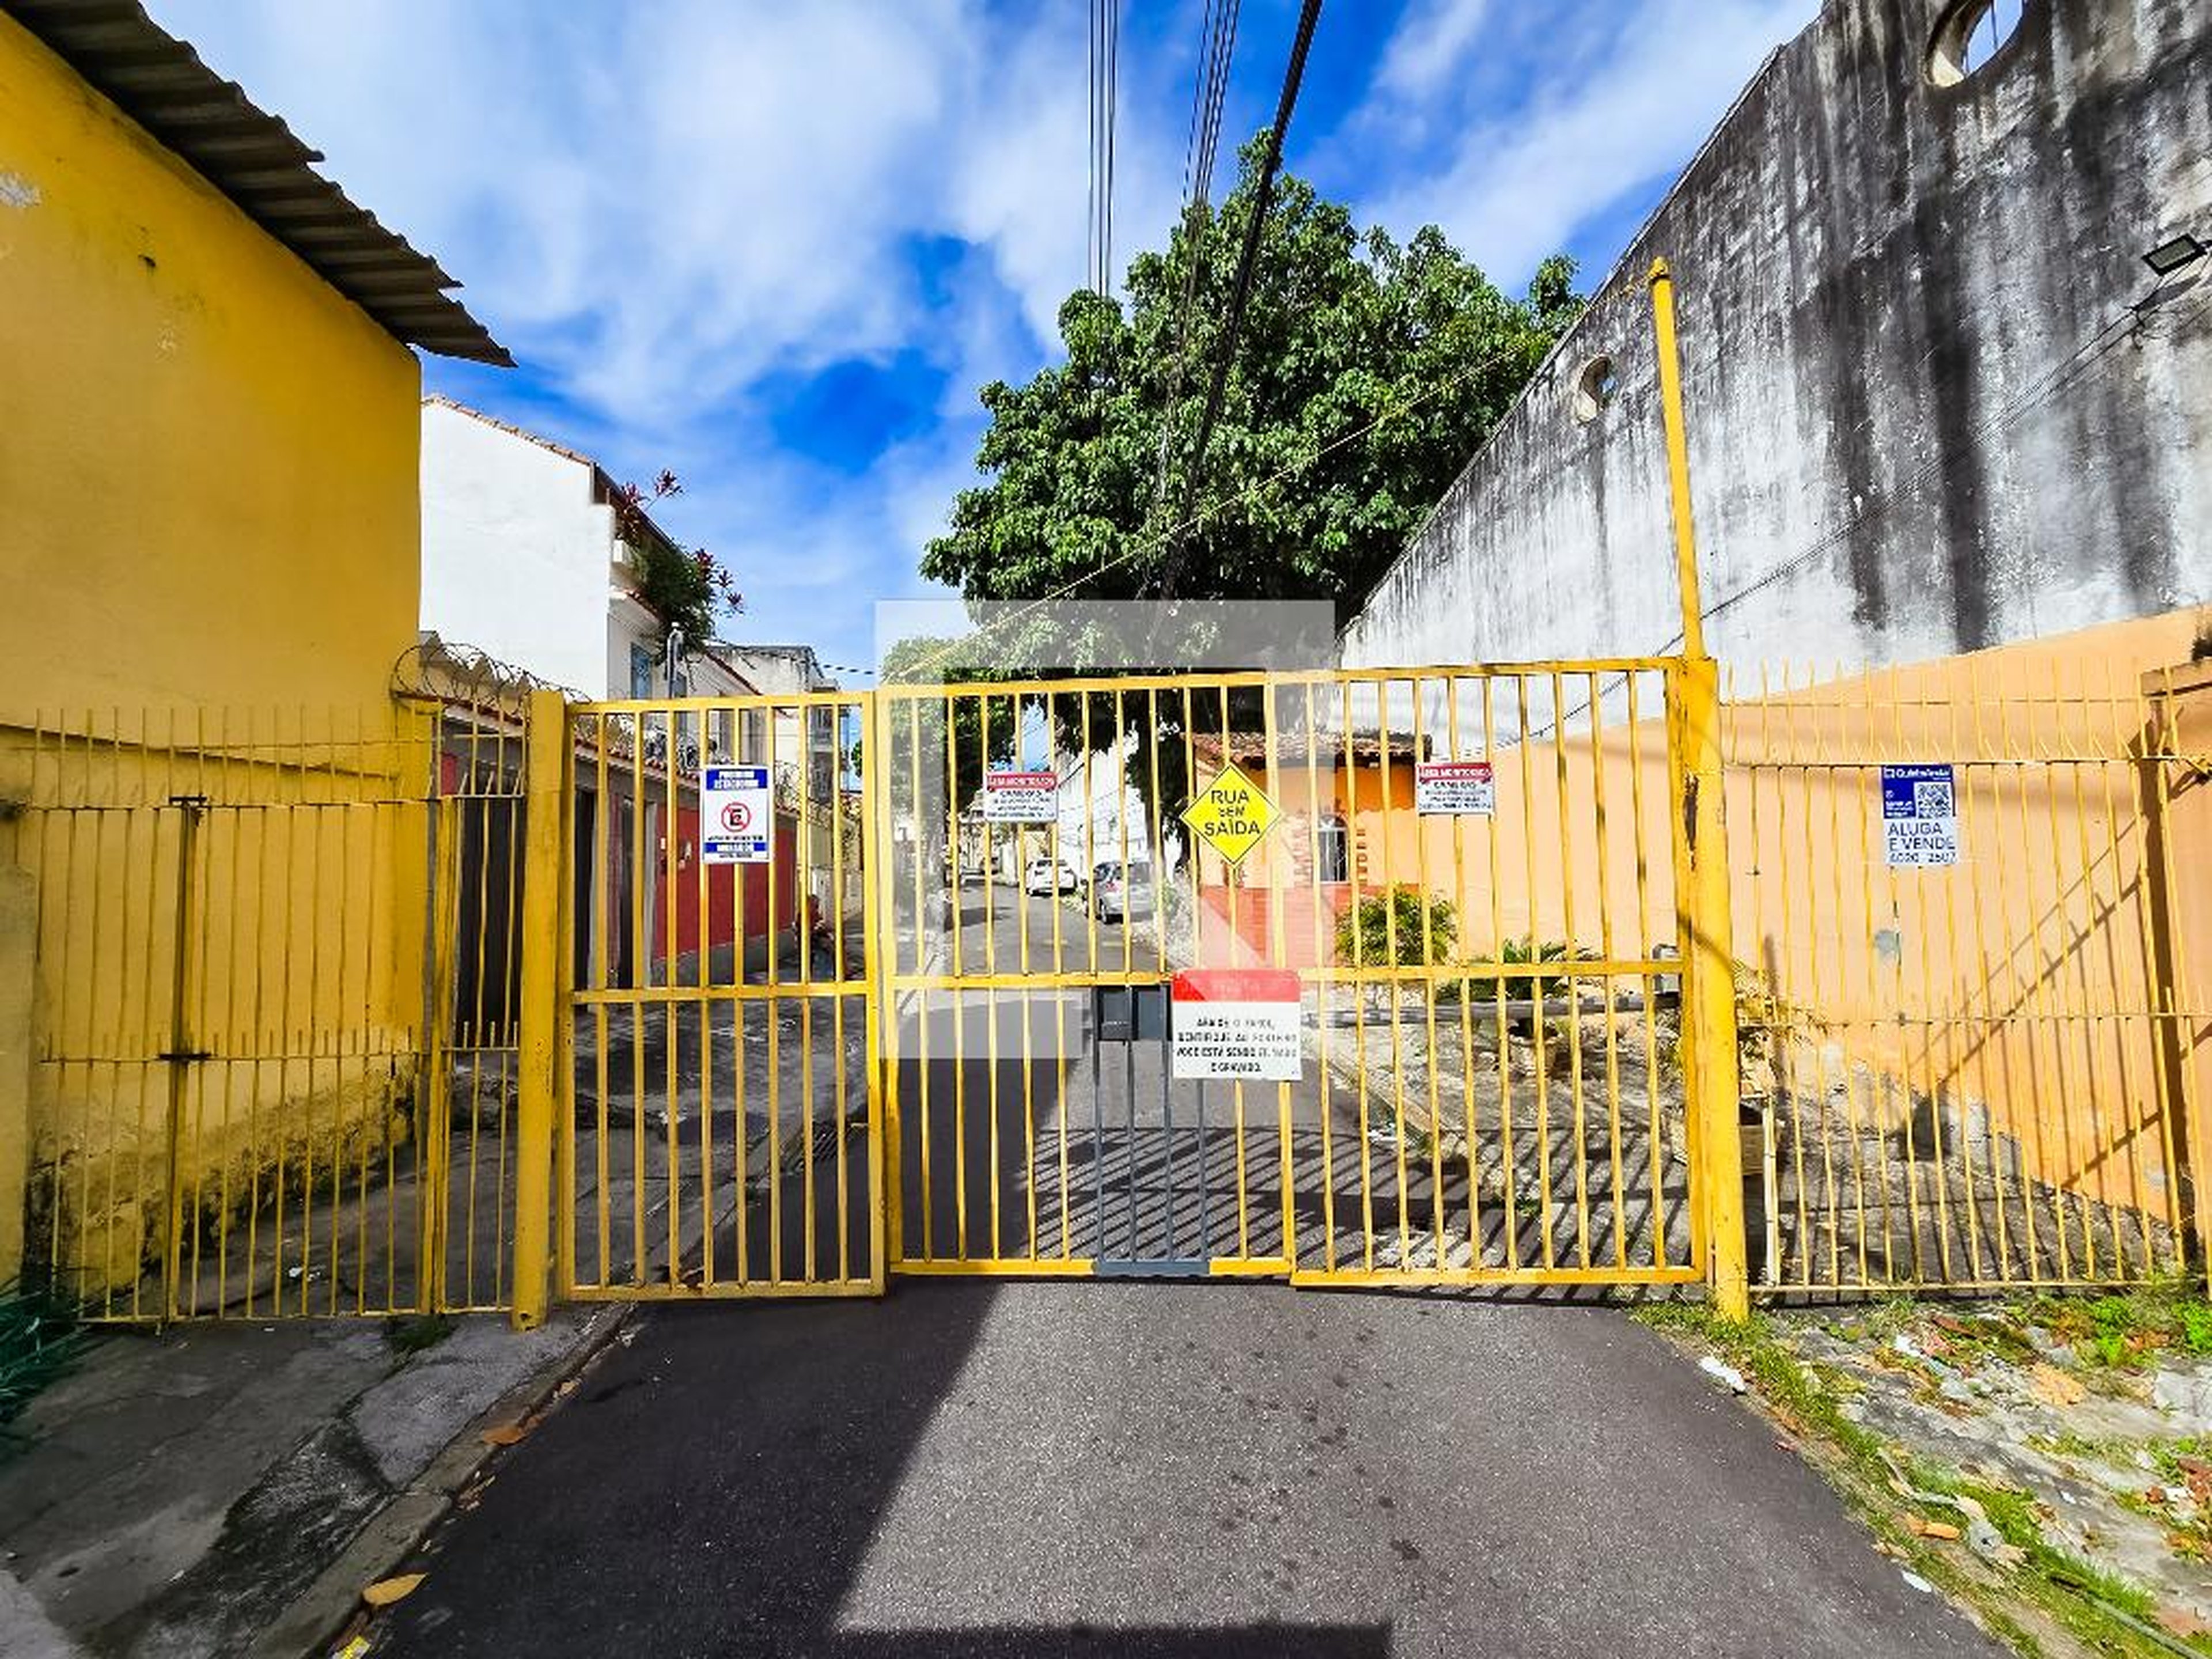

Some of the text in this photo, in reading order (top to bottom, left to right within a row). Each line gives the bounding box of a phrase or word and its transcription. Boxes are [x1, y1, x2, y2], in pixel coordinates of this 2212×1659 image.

[1211, 789, 1249, 804] RUA
[1204, 819, 1260, 836] SAÍDA
[1888, 822, 1943, 836] ALUGA
[1889, 836, 1956, 851] E VENDE
